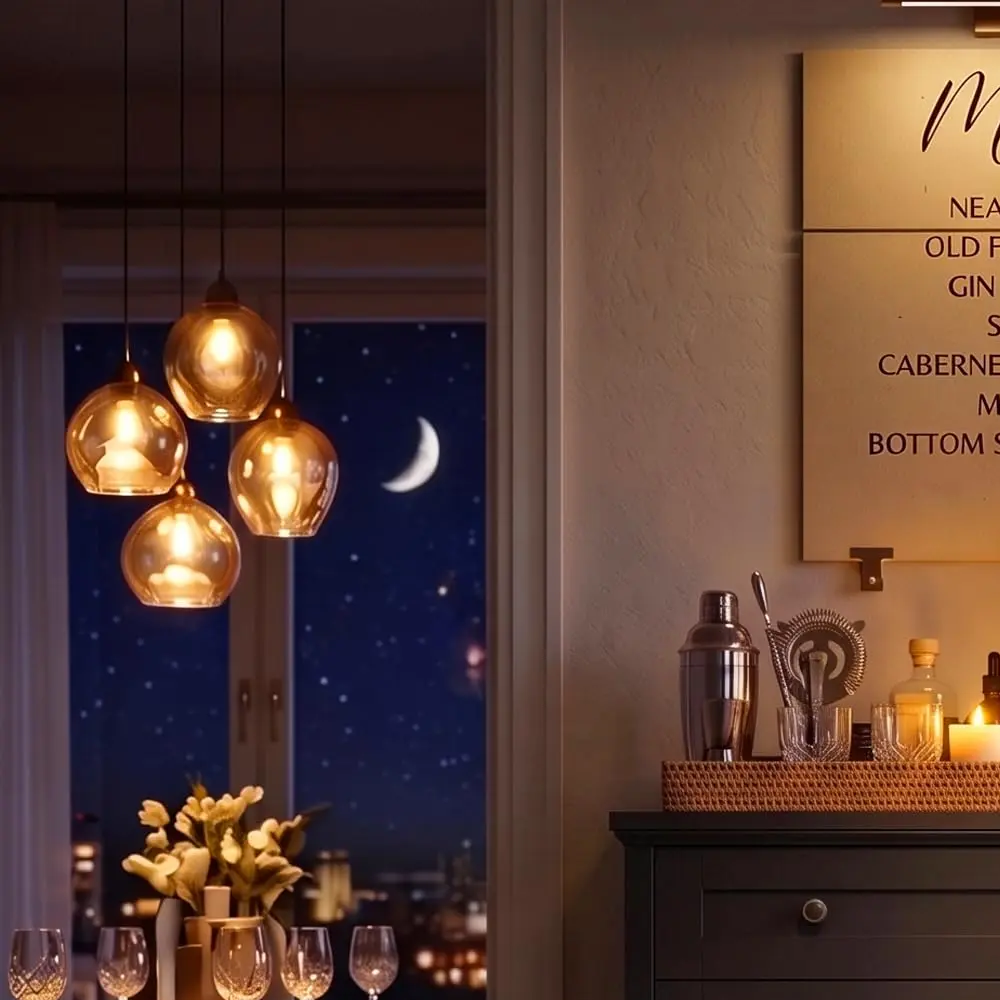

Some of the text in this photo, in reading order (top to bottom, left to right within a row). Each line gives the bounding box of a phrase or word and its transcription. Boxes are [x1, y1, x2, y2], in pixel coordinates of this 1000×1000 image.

[924, 235, 980, 259] OLD
[947, 274, 995, 298] GIN
[867, 432, 985, 456] BOTTOM
